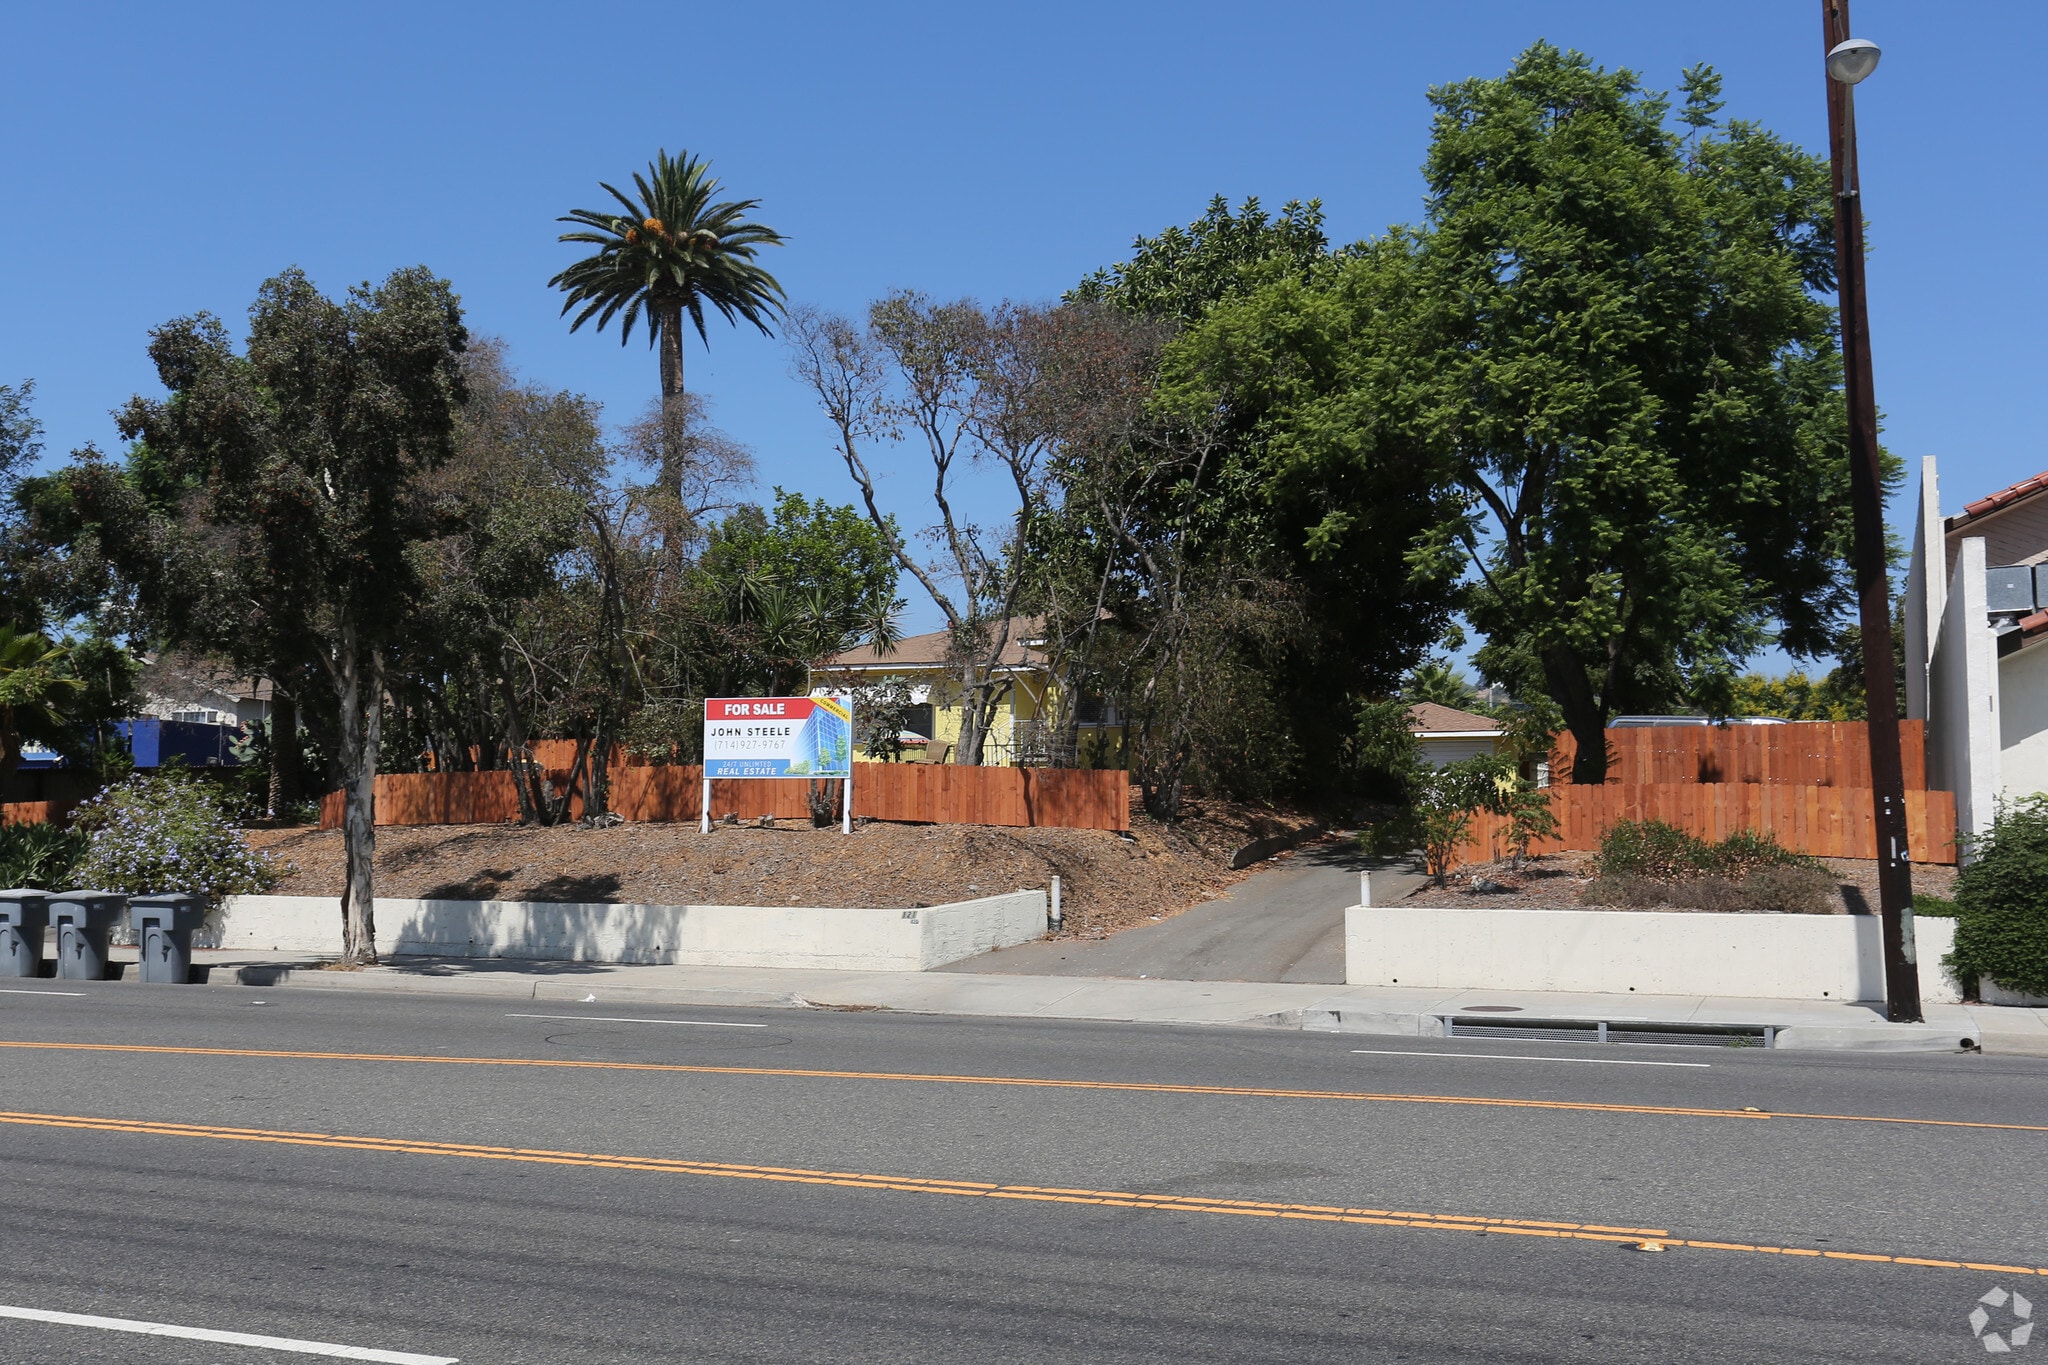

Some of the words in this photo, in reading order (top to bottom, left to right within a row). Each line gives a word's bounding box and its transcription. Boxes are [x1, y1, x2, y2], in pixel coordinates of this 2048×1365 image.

[724, 703, 750, 716] FOR
[753, 702, 785, 715] SALE
[820, 698, 849, 719] COMMERCIAL
[711, 728, 742, 737] JOHN
[747, 727, 791, 736] STEELE
[714, 740, 786, 751] (714)927-9767
[717, 767, 740, 775] REAL
[743, 767, 777, 775] ESTATE
